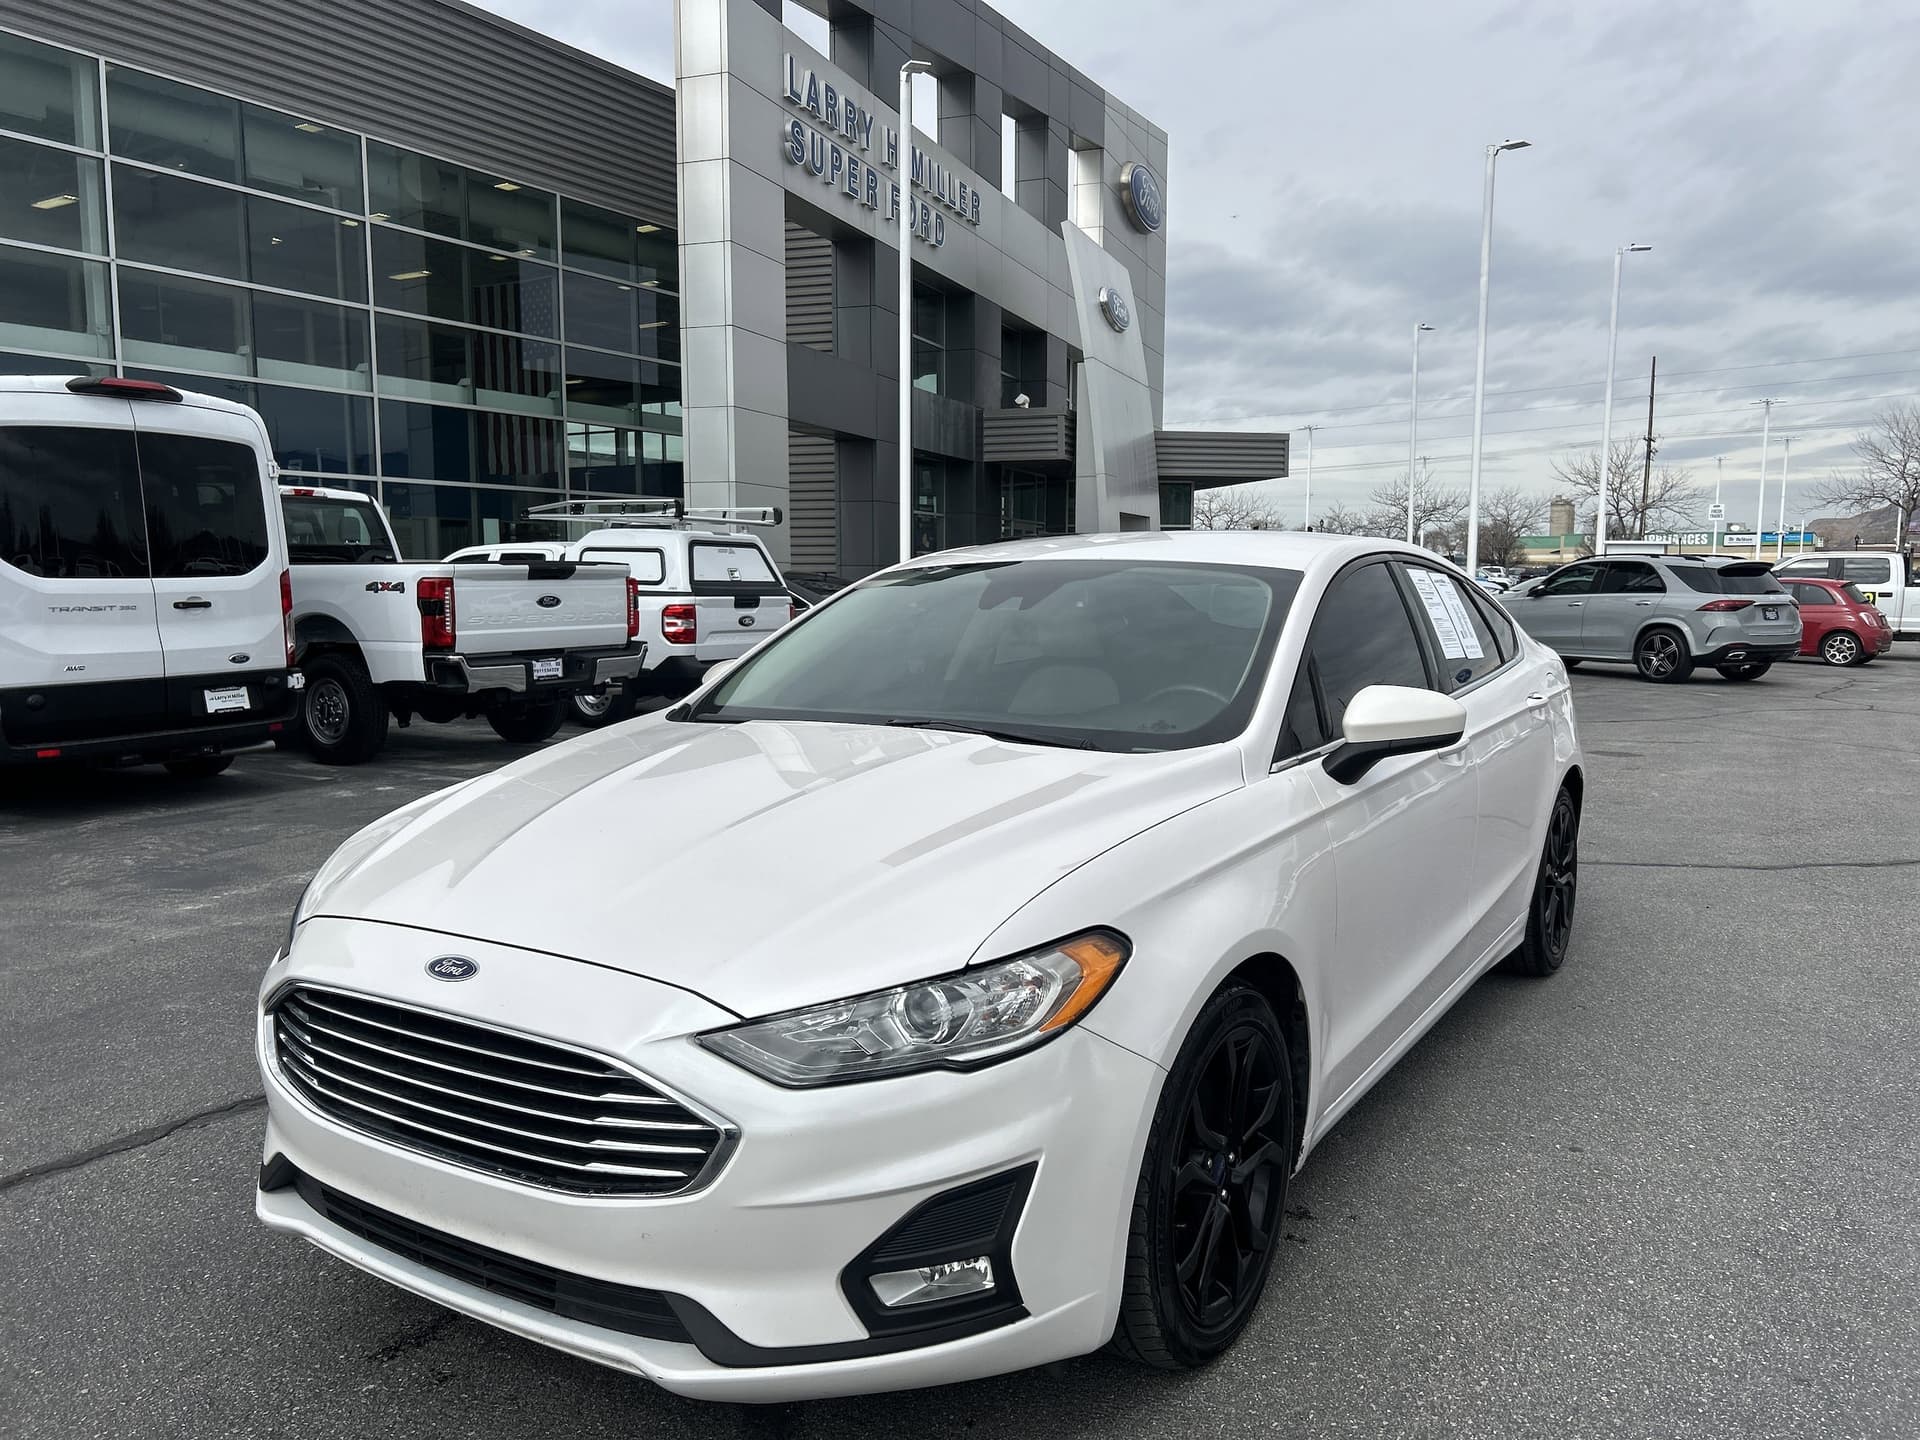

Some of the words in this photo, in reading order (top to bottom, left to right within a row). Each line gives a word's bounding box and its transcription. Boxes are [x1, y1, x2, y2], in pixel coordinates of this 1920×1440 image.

[784, 53, 874, 151] LARRY
[910, 144, 981, 225] MILLER
[784, 118, 878, 211] SUPER
[48, 605, 116, 613] TRANSIT
[466, 613, 553, 626] SUPER
[561, 611, 621, 623] DUTY
[64, 664, 86, 672] AWD
[434, 958, 468, 976] Ford
